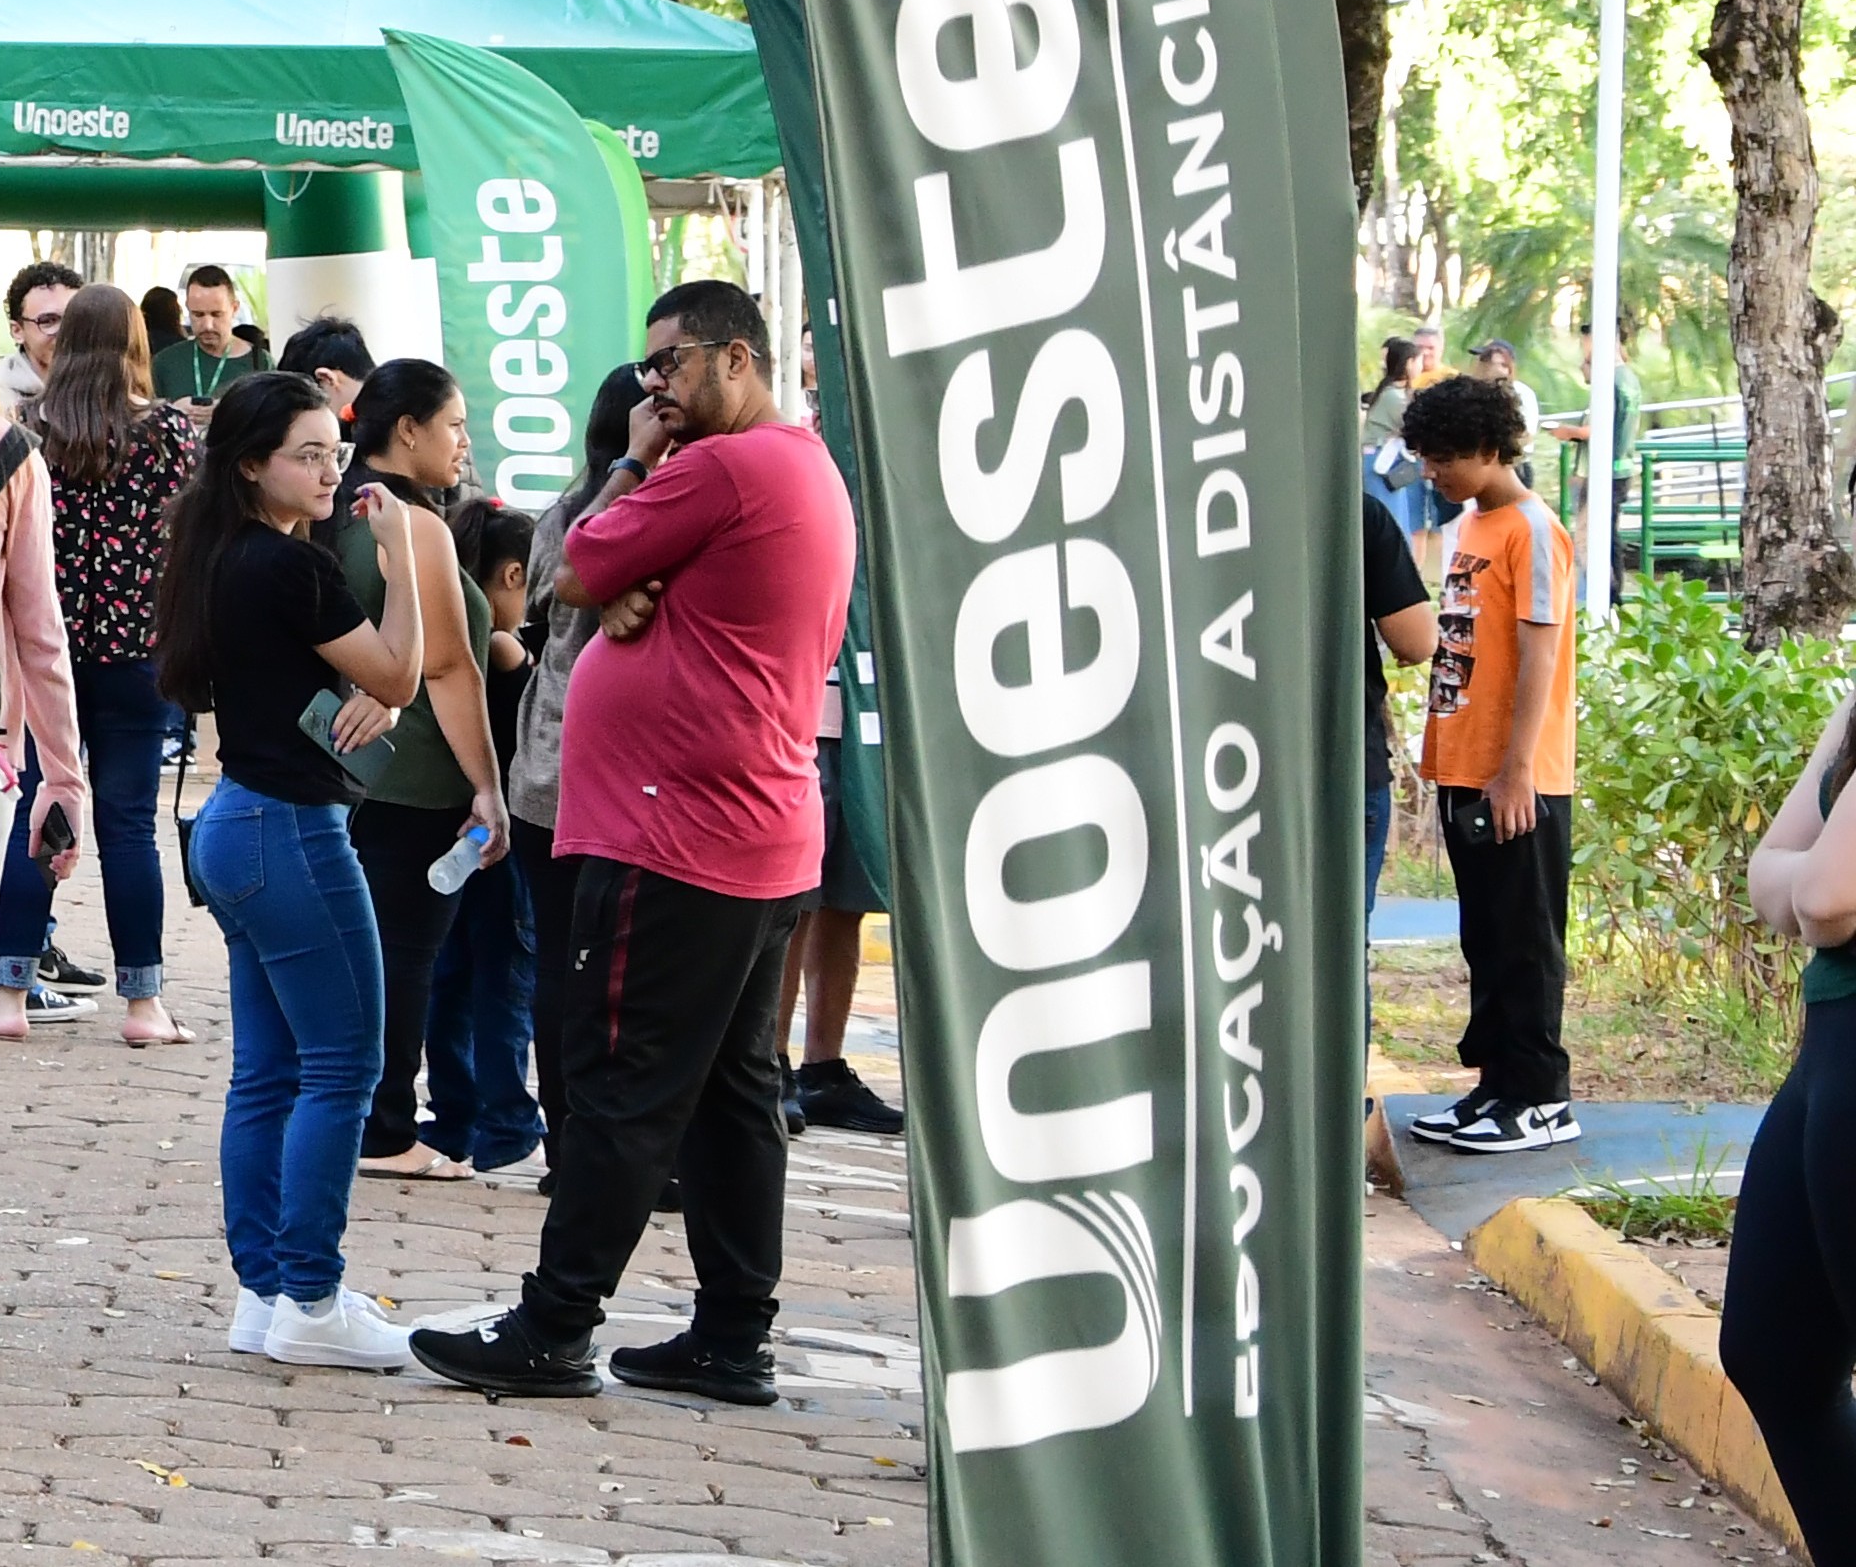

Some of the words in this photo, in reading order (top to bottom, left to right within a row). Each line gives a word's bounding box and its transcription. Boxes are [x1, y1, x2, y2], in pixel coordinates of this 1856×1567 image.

[13, 101, 131, 139] Unoeste
[275, 112, 395, 150] Unoeste
[466, 177, 574, 511] noeste
[1199, 589, 1257, 681] A
